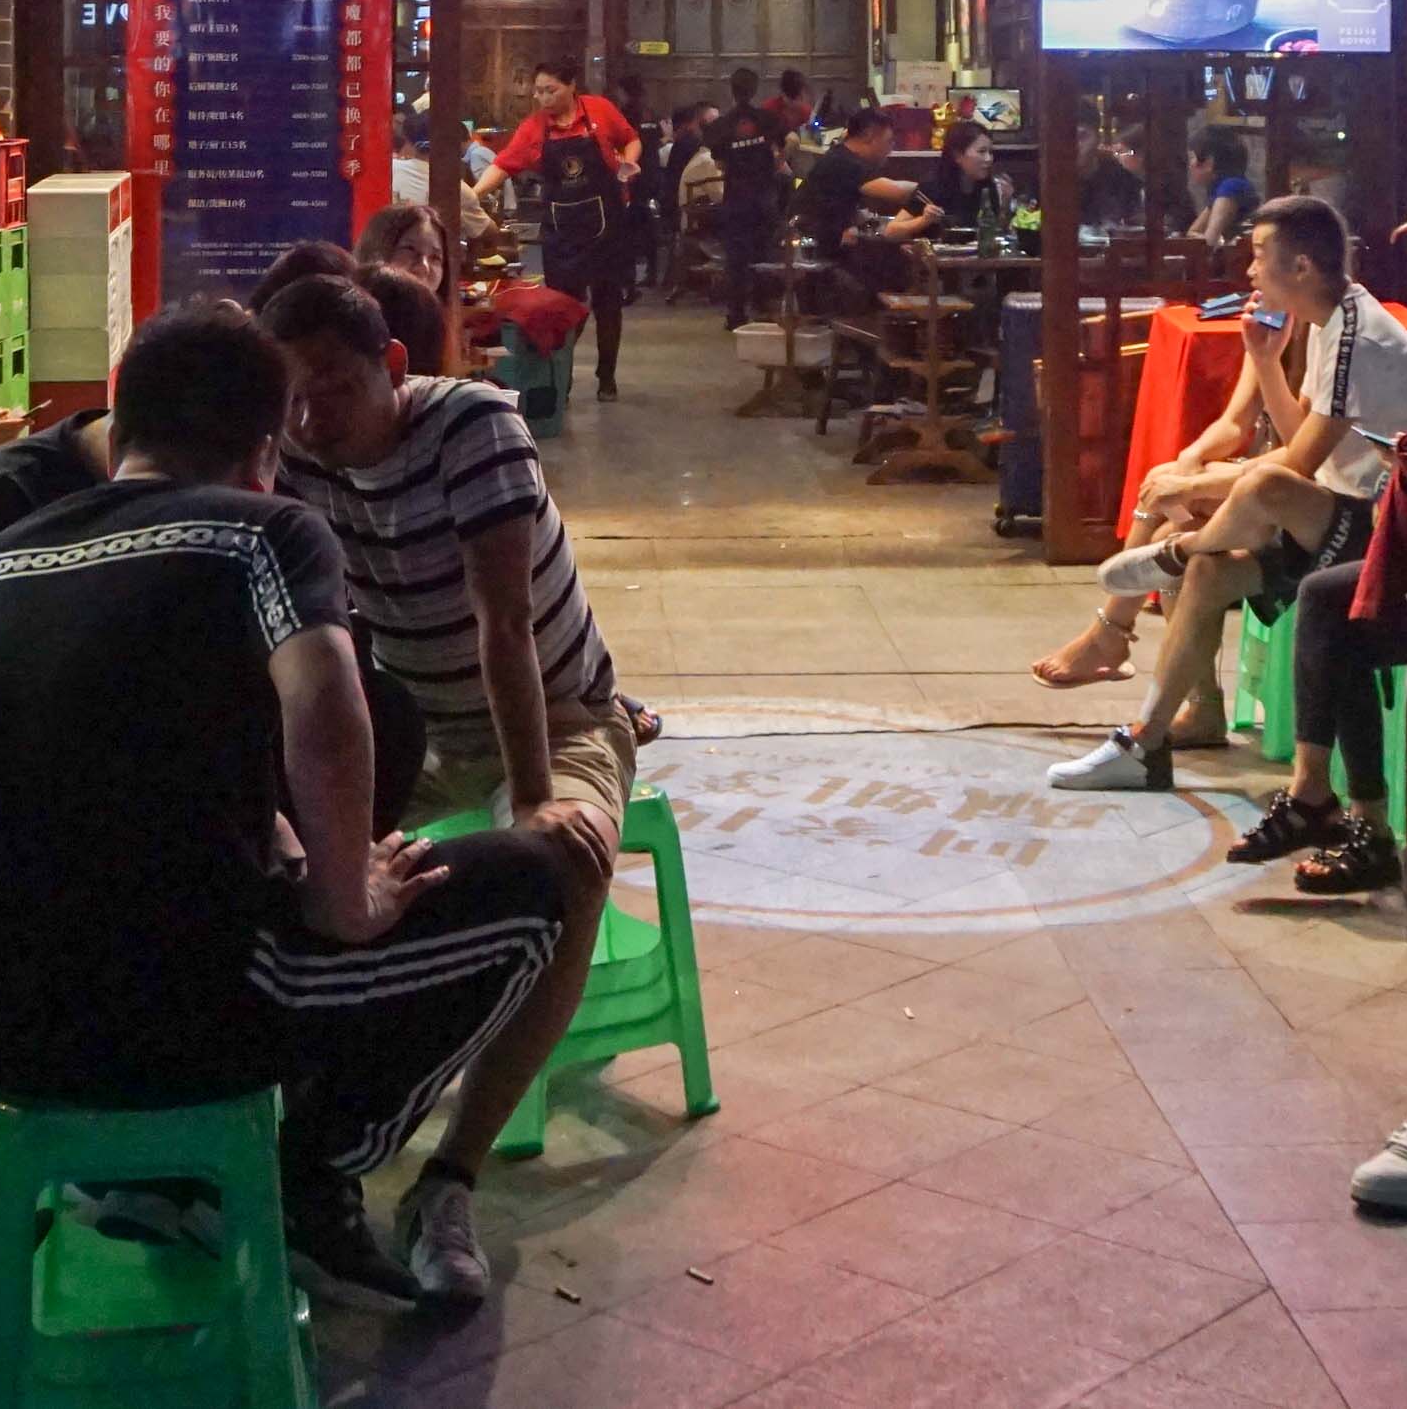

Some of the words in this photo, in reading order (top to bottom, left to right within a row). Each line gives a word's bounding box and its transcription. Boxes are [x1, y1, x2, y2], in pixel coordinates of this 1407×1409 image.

[153, 3, 171, 177] 我要的你在哪里
[344, 3, 363, 177] 魔都都已换了季
